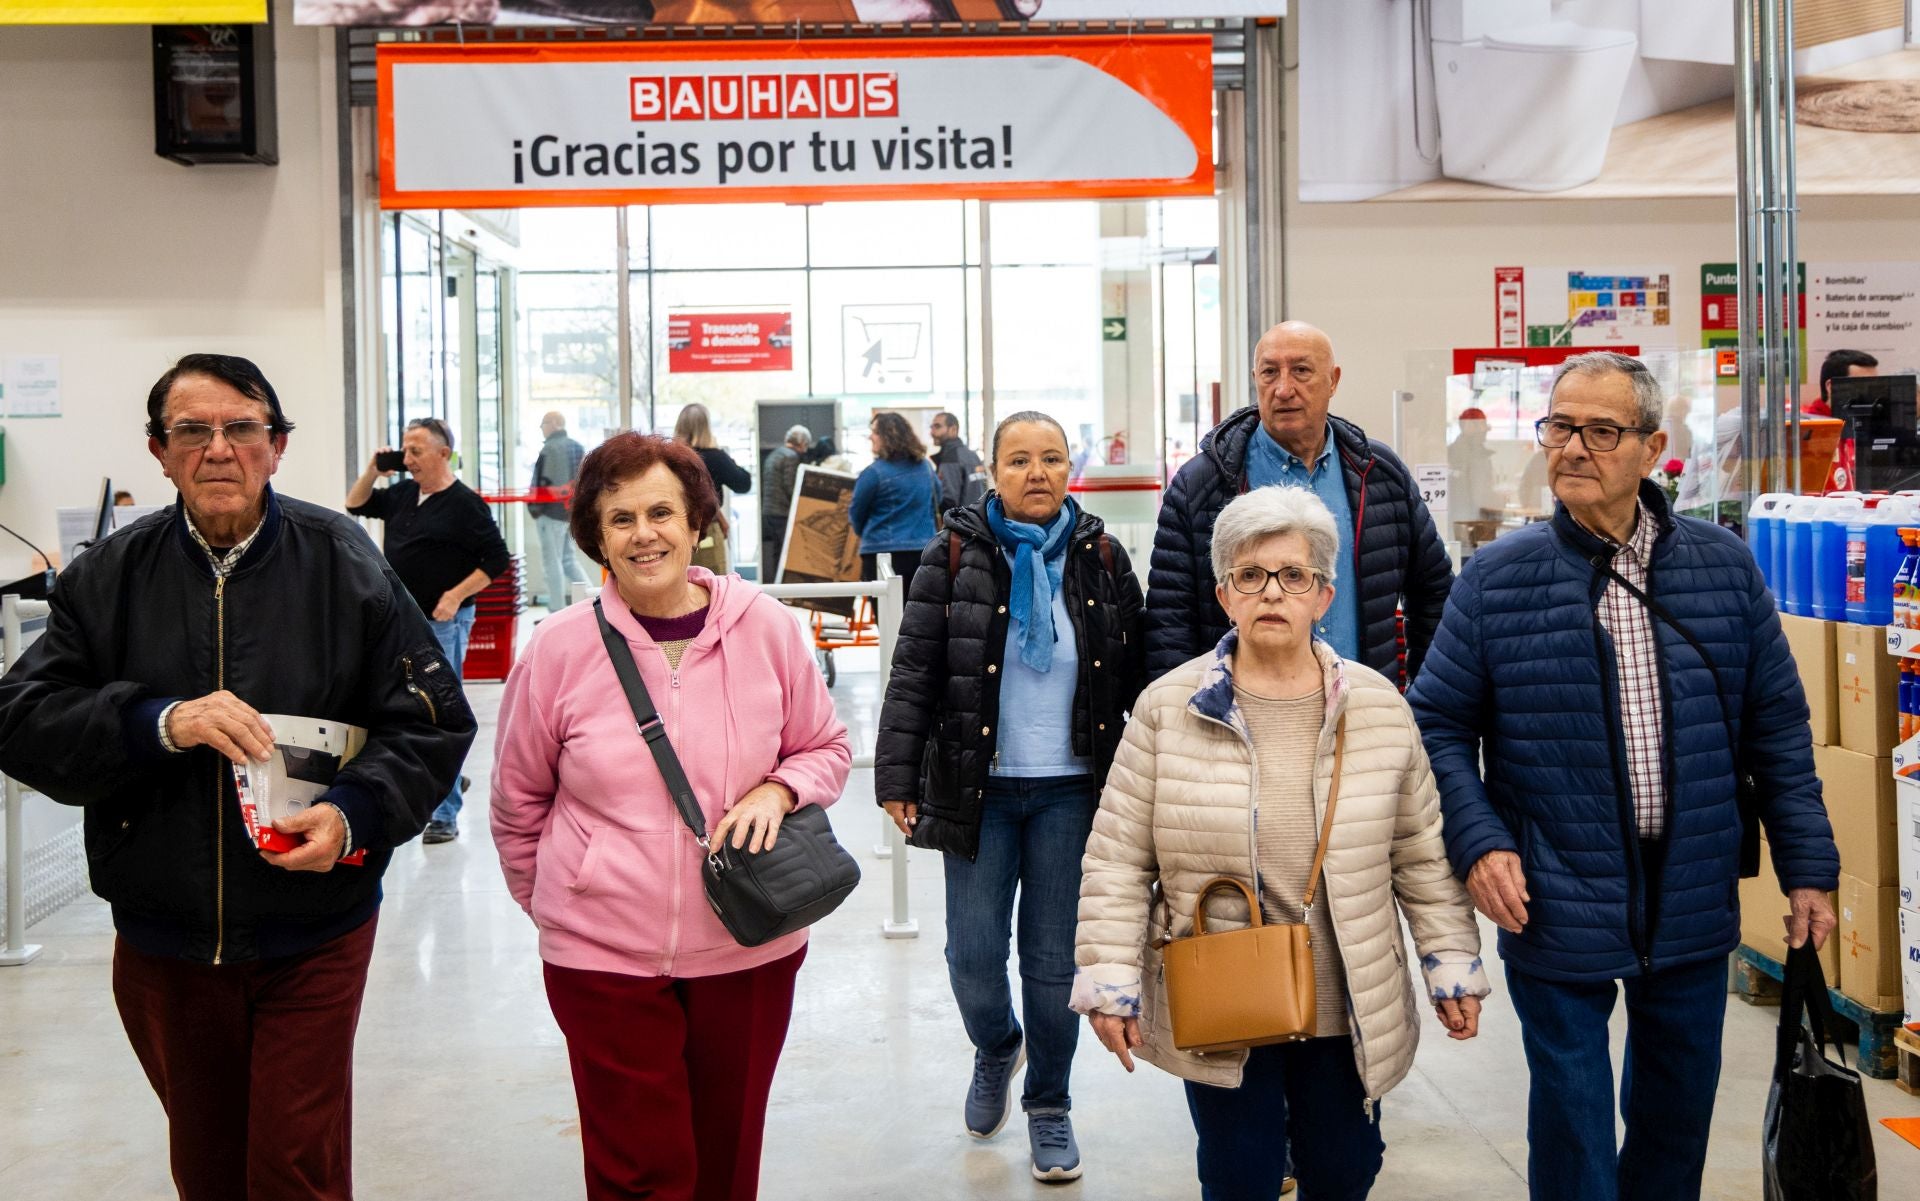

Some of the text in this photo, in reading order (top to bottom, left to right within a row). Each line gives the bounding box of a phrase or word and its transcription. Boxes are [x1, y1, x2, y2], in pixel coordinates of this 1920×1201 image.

[632, 75, 895, 118] BAUHAUS
[513, 125, 1013, 184] ¡Gracias por tu visita!
[1705, 273, 1737, 285] Punto
[1857, 293, 1867, 302] de
[1825, 310, 1849, 318] Aceite
[1851, 310, 1864, 318] del
[701, 322, 760, 336] Transporte
[1825, 324, 1830, 332] y
[1832, 322, 1840, 331] la
[1841, 323, 1858, 332] caja
[1860, 322, 1869, 331] de
[701, 334, 760, 347] a domicilio
